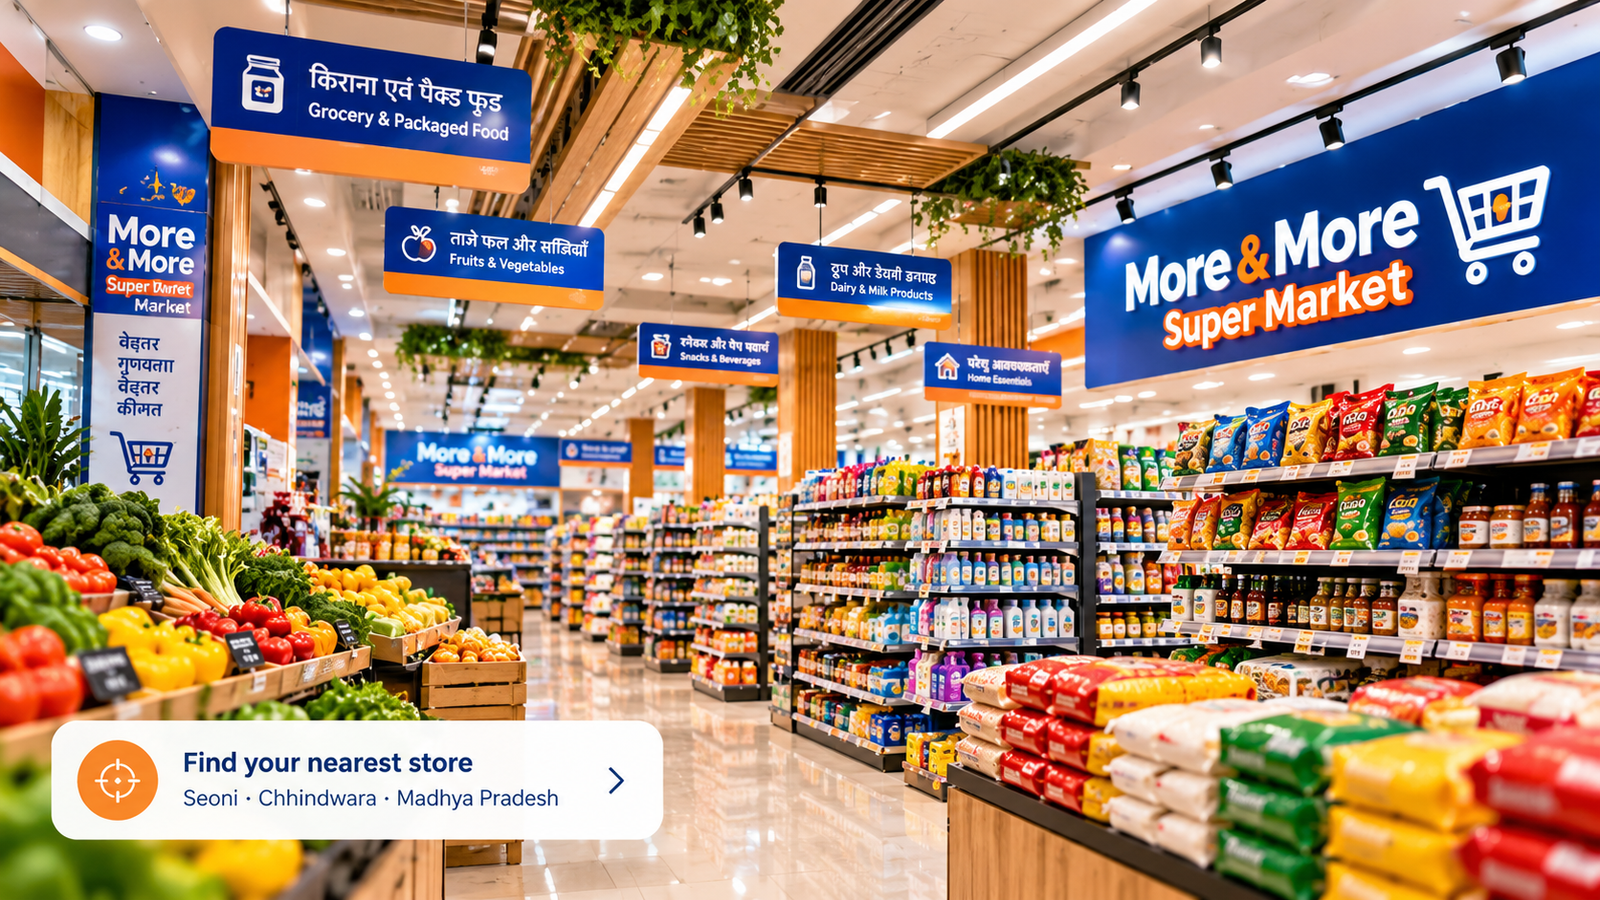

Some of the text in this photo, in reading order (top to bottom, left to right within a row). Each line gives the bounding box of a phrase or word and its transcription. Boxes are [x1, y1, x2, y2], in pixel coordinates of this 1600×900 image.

[308, 62, 379, 96] किराना
[382, 77, 413, 103] एवं
[308, 102, 509, 142] Grocery & Packaged Food
[108, 214, 195, 250] More
[480, 234, 510, 250] फल
[512, 234, 538, 252] और
[106, 248, 194, 275] & More
[450, 253, 565, 275] Fruits & Vegetables
[1125, 200, 1420, 312] More & More
[852, 262, 872, 278] और
[107, 277, 150, 296] Super
[830, 282, 934, 300] Dairy & Milk Products
[134, 298, 192, 314] Market
[1165, 262, 1407, 349] Super Market
[680, 352, 761, 367] Snacks & Beverages
[968, 373, 1032, 387] Home Essentials
[116, 397, 163, 417] कीमत
[416, 441, 538, 466] More & More
[434, 463, 528, 480] Super Market
